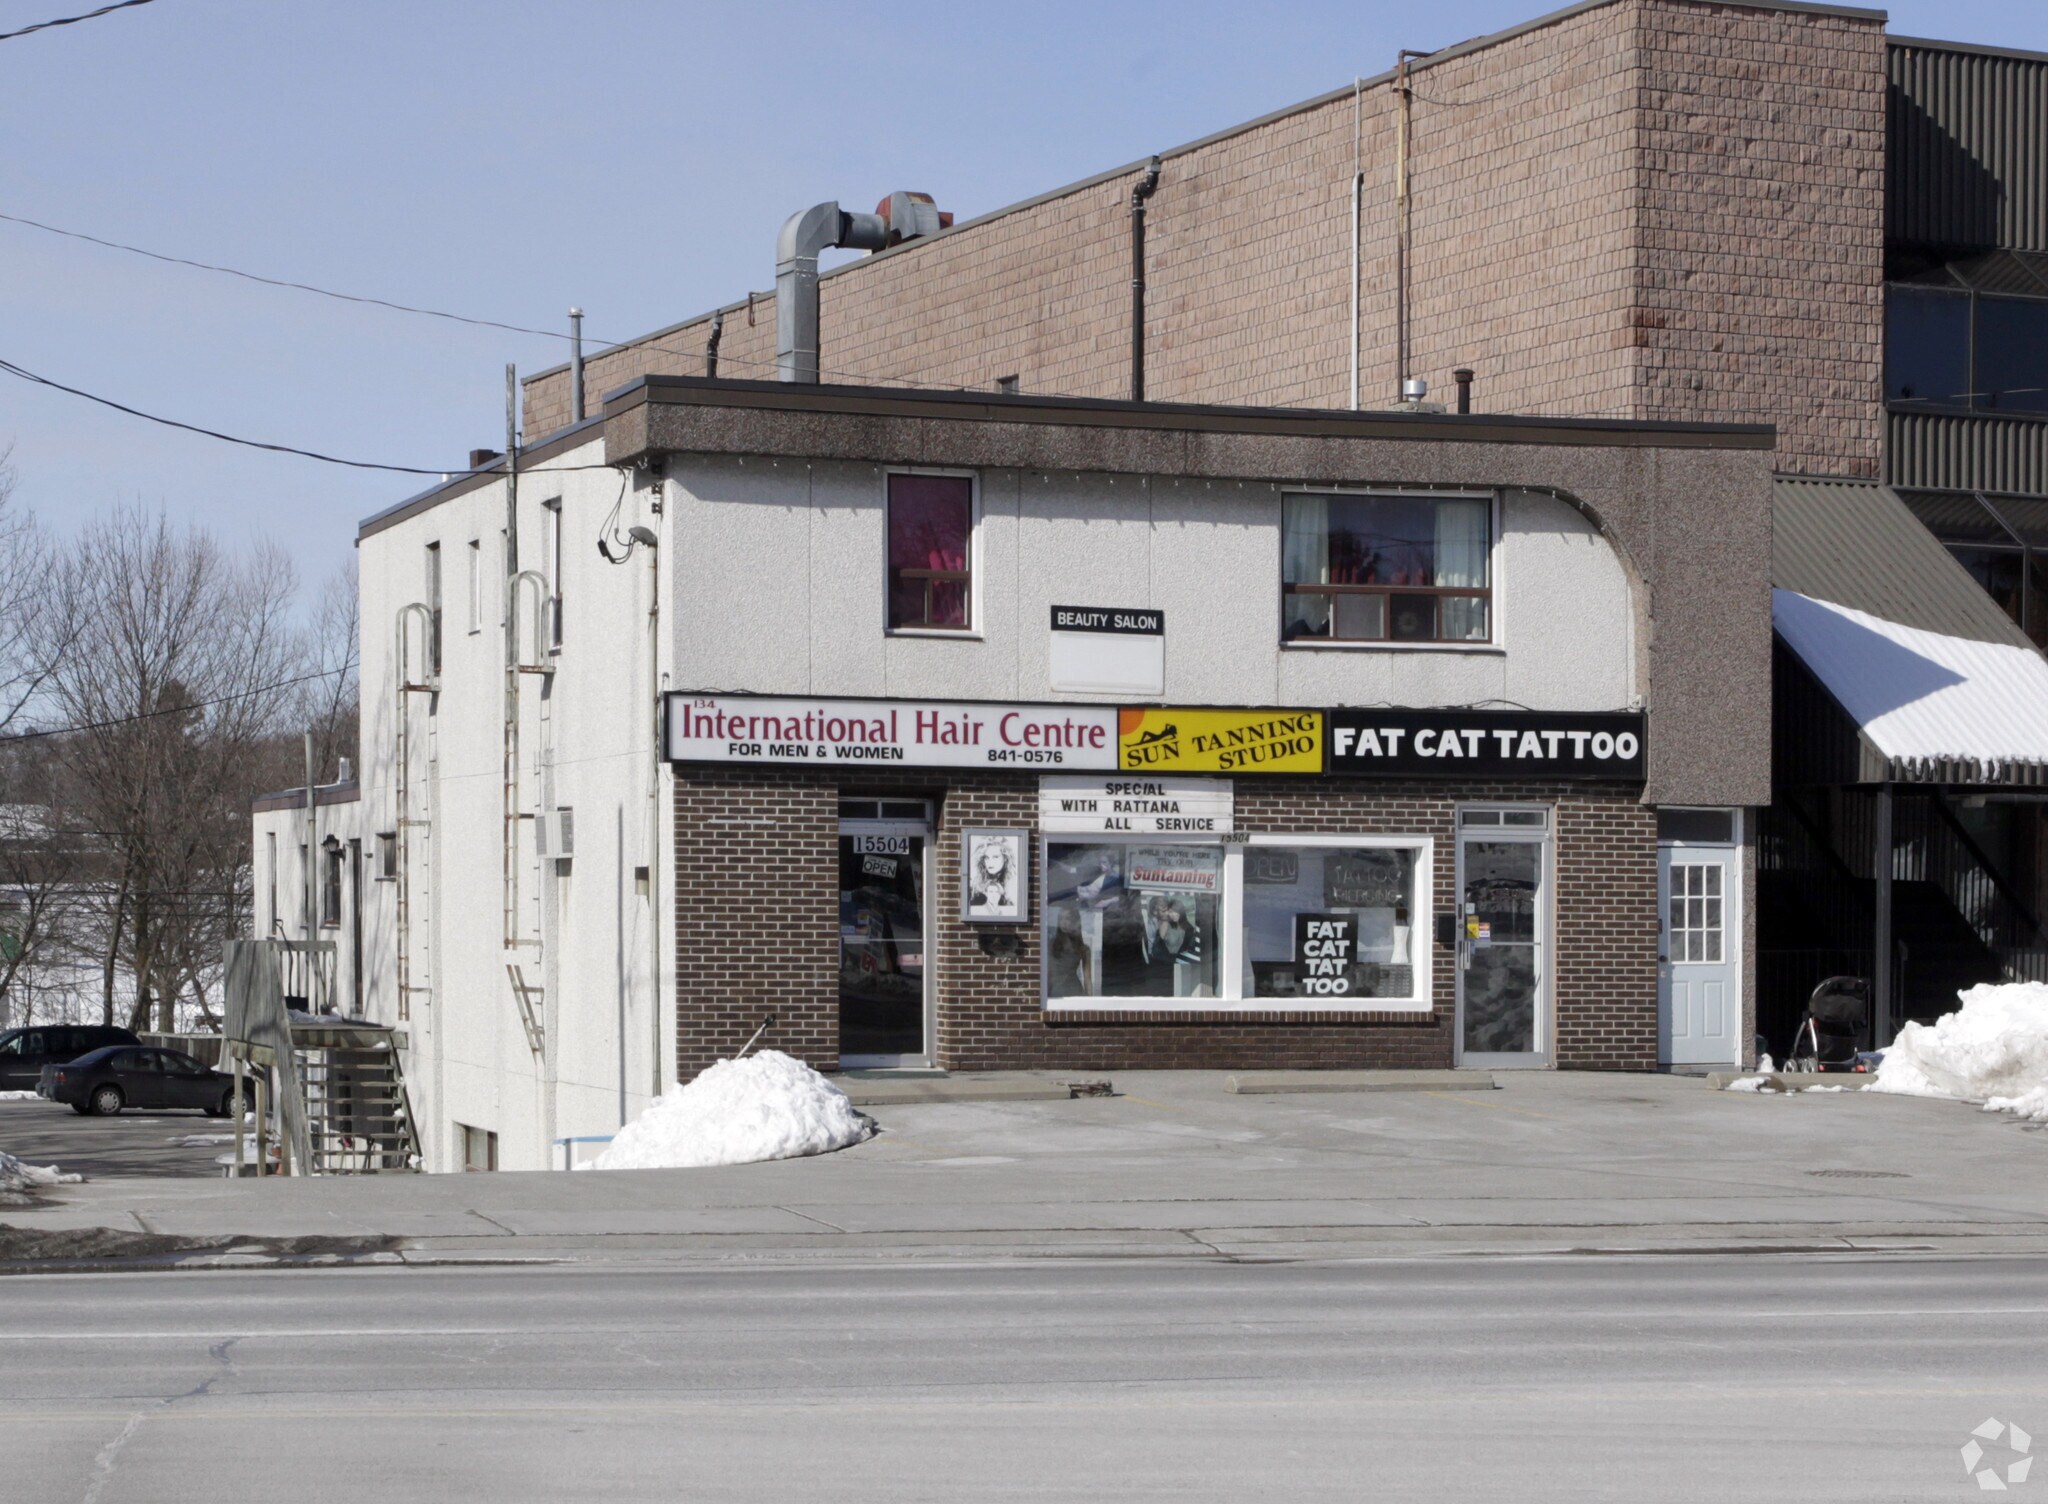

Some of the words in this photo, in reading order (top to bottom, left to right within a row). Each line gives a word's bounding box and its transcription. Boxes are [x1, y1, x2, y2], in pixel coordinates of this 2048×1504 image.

[1057, 612, 1108, 627] BEAUTY
[1114, 614, 1157, 629] SALON
[694, 700, 716, 708] 134
[683, 704, 898, 743] International
[915, 710, 984, 745] Hair
[999, 712, 1106, 749] Centre
[1127, 741, 1180, 767] SUN
[1192, 713, 1315, 753] TANNING
[1334, 728, 1405, 756] FAT
[1414, 729, 1486, 758] CAT
[1493, 730, 1638, 760] TATTOO
[729, 743, 762, 756] FOR
[769, 744, 809, 757] MEN
[816, 745, 827, 757] &
[835, 746, 904, 759] WOMEN
[988, 749, 1063, 763] 841-0576
[1219, 736, 1314, 770] STUDIO
[1106, 782, 1165, 796] SPECIAL
[1061, 799, 1097, 812] WITH
[1113, 800, 1180, 813] RATTANA
[1104, 817, 1131, 830] ALL
[1156, 818, 1214, 831] SERVICE
[856, 836, 908, 853] 15504
[1221, 834, 1250, 843] 15504
[1138, 849, 1160, 857] WHILE
[862, 860, 896, 876] OPEN
[1243, 856, 1296, 877] OPEN
[1335, 865, 1402, 884] TATTOO
[1133, 866, 1216, 889] Suntanning
[1307, 921, 1348, 939] FAT
[1303, 939, 1350, 957] CAT
[1305, 958, 1348, 976] TAT
[1302, 977, 1349, 994] TOO
